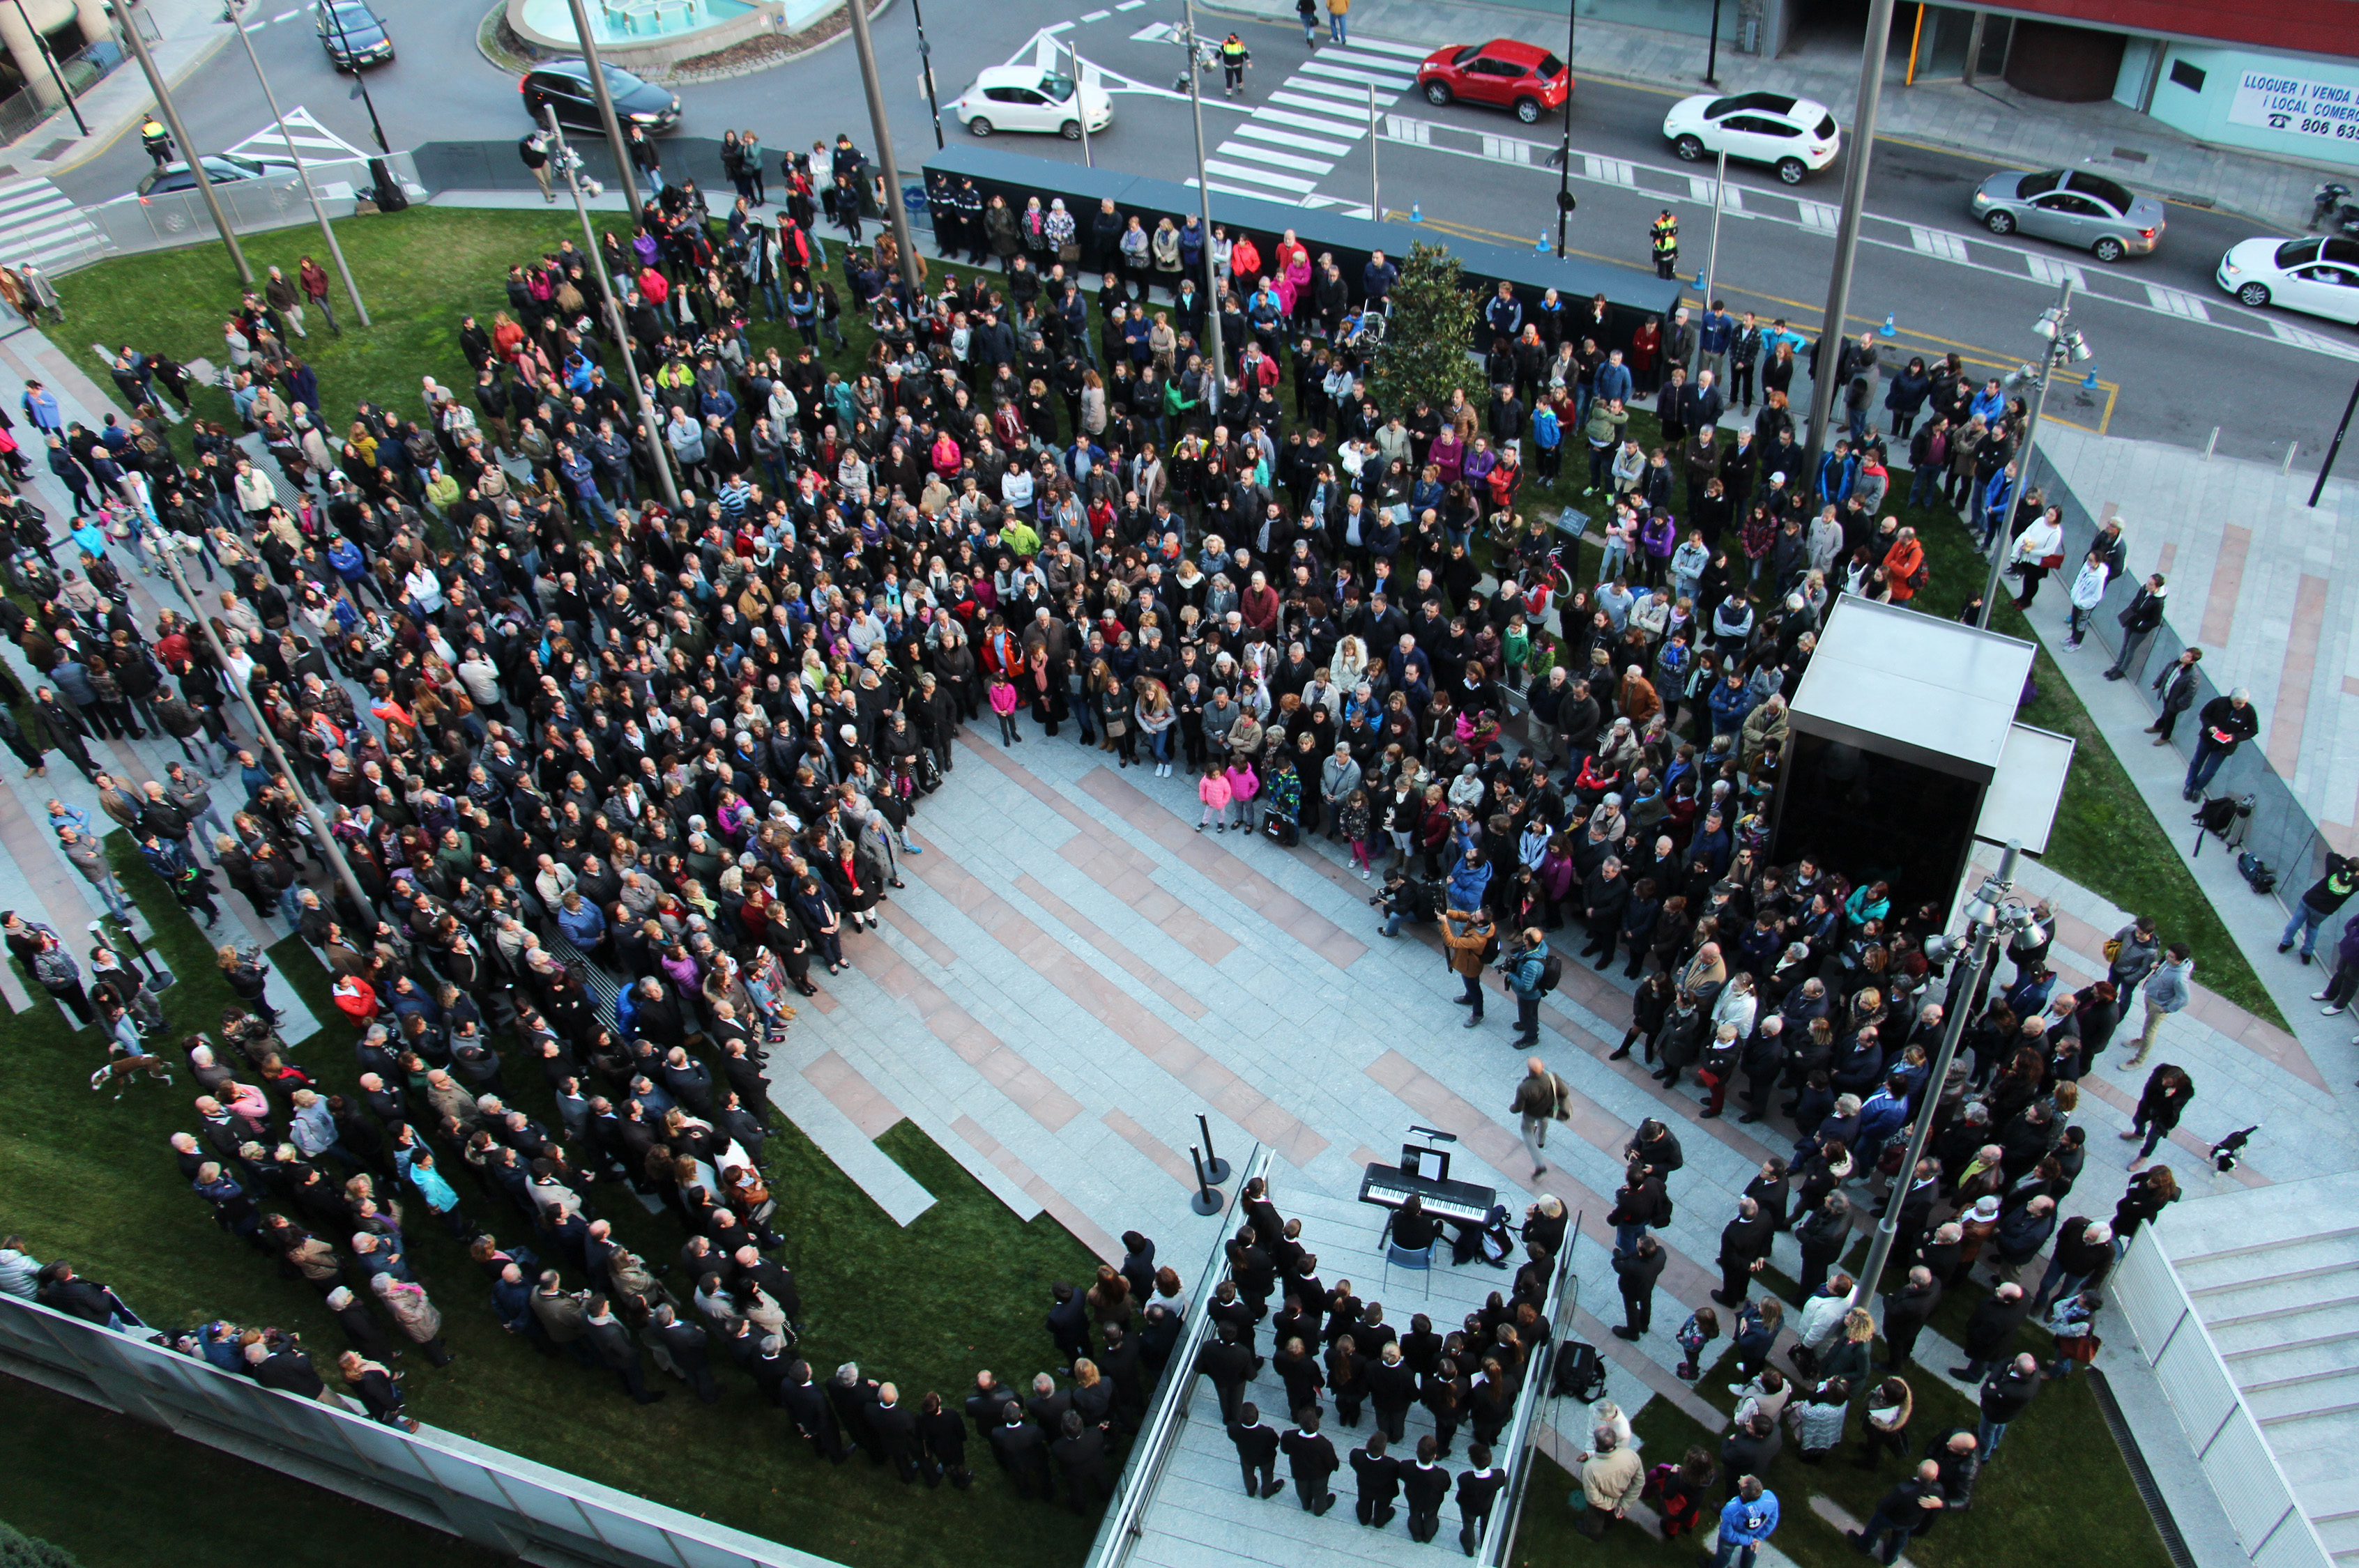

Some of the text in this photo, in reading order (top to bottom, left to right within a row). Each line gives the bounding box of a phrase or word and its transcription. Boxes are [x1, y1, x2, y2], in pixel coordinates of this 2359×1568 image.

[2244, 75, 2298, 95] LLOGUER
[2312, 85, 2351, 104] VENDA
[2271, 96, 2307, 114] LOCAL
[2300, 118, 2330, 135] 806
[1267, 827, 1278, 836] AND
